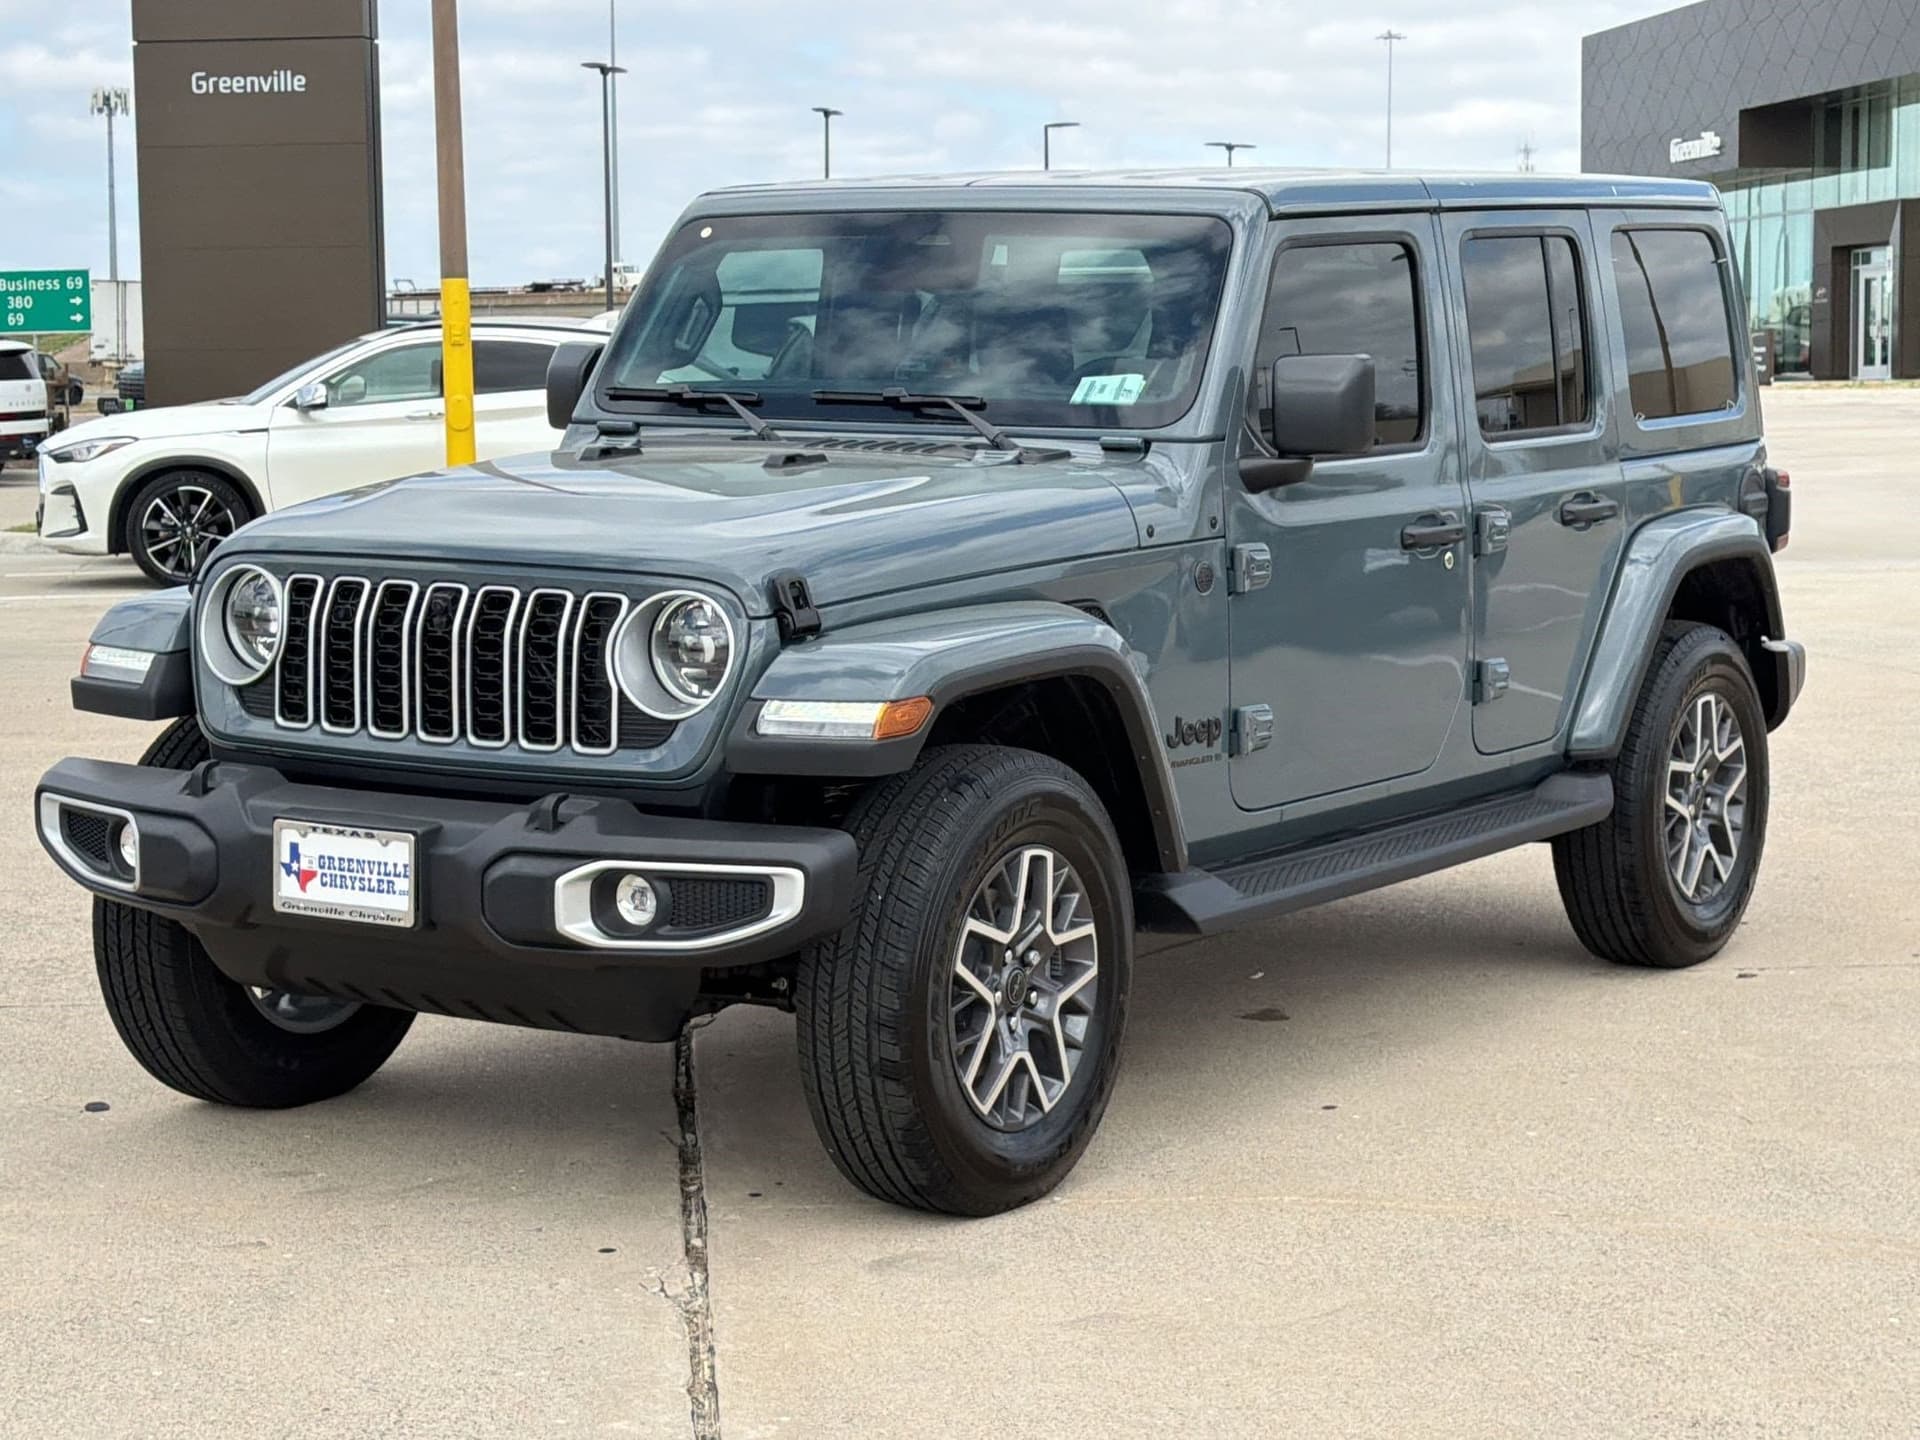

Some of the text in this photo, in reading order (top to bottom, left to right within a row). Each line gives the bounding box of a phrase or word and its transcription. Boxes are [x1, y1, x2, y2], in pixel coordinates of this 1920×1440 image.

[191, 69, 306, 94] Greenville
[0, 276, 83, 292] Business 69
[7, 295, 33, 309] 380
[7, 312, 24, 326] 69
[1166, 715, 1221, 749] Jeep
[309, 825, 376, 839] TEXAS
[318, 854, 409, 878] GREENVILLE
[320, 872, 396, 895] CHRYSLER
[281, 901, 345, 916] Greenville
[349, 909, 404, 923] Chrysler
